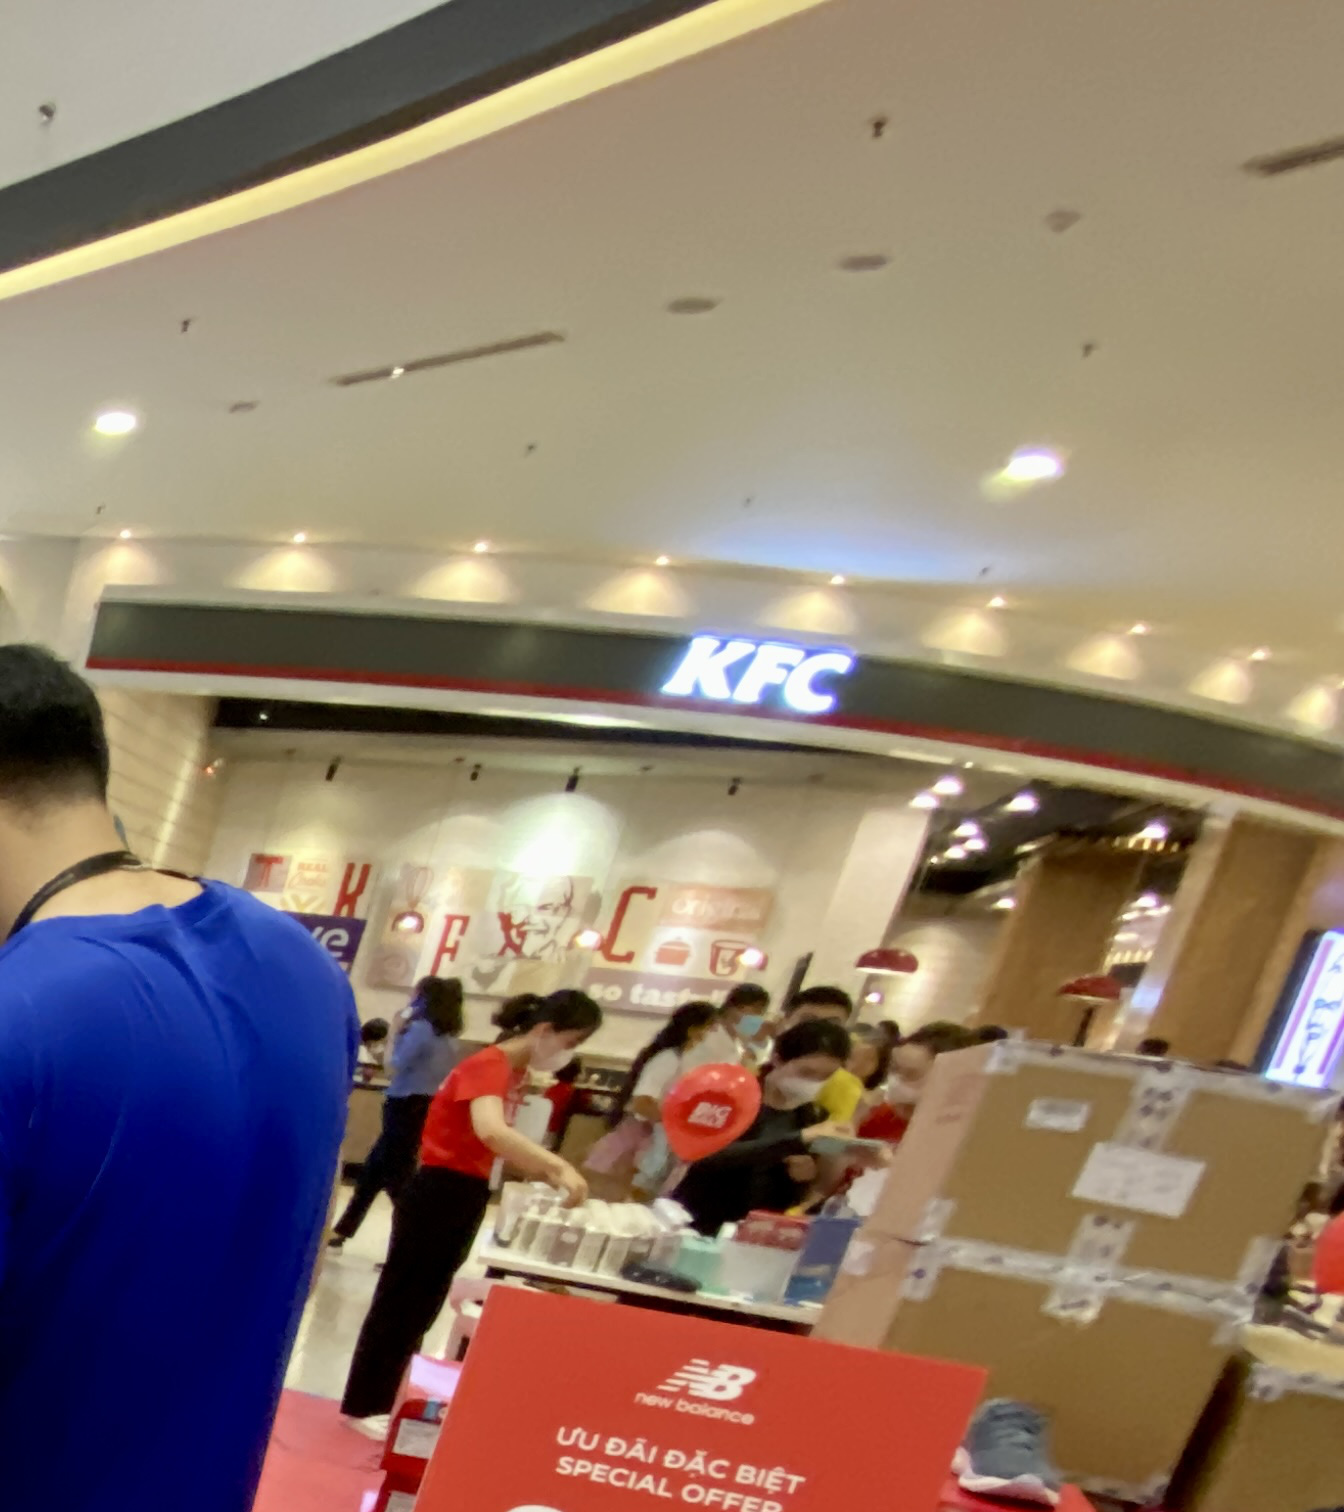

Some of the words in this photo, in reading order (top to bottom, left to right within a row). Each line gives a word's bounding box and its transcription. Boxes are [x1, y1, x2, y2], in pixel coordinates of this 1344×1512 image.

[662, 634, 856, 714] KFC
[634, 1392, 675, 1409] new
[676, 1398, 755, 1426] balance
[555, 1455, 673, 1498] SPECIAL
[556, 1425, 601, 1451] ƯU
[604, 1437, 659, 1464] ĐÃI
[663, 1448, 731, 1479] ĐẶC
[734, 1465, 807, 1495] BIỆT
